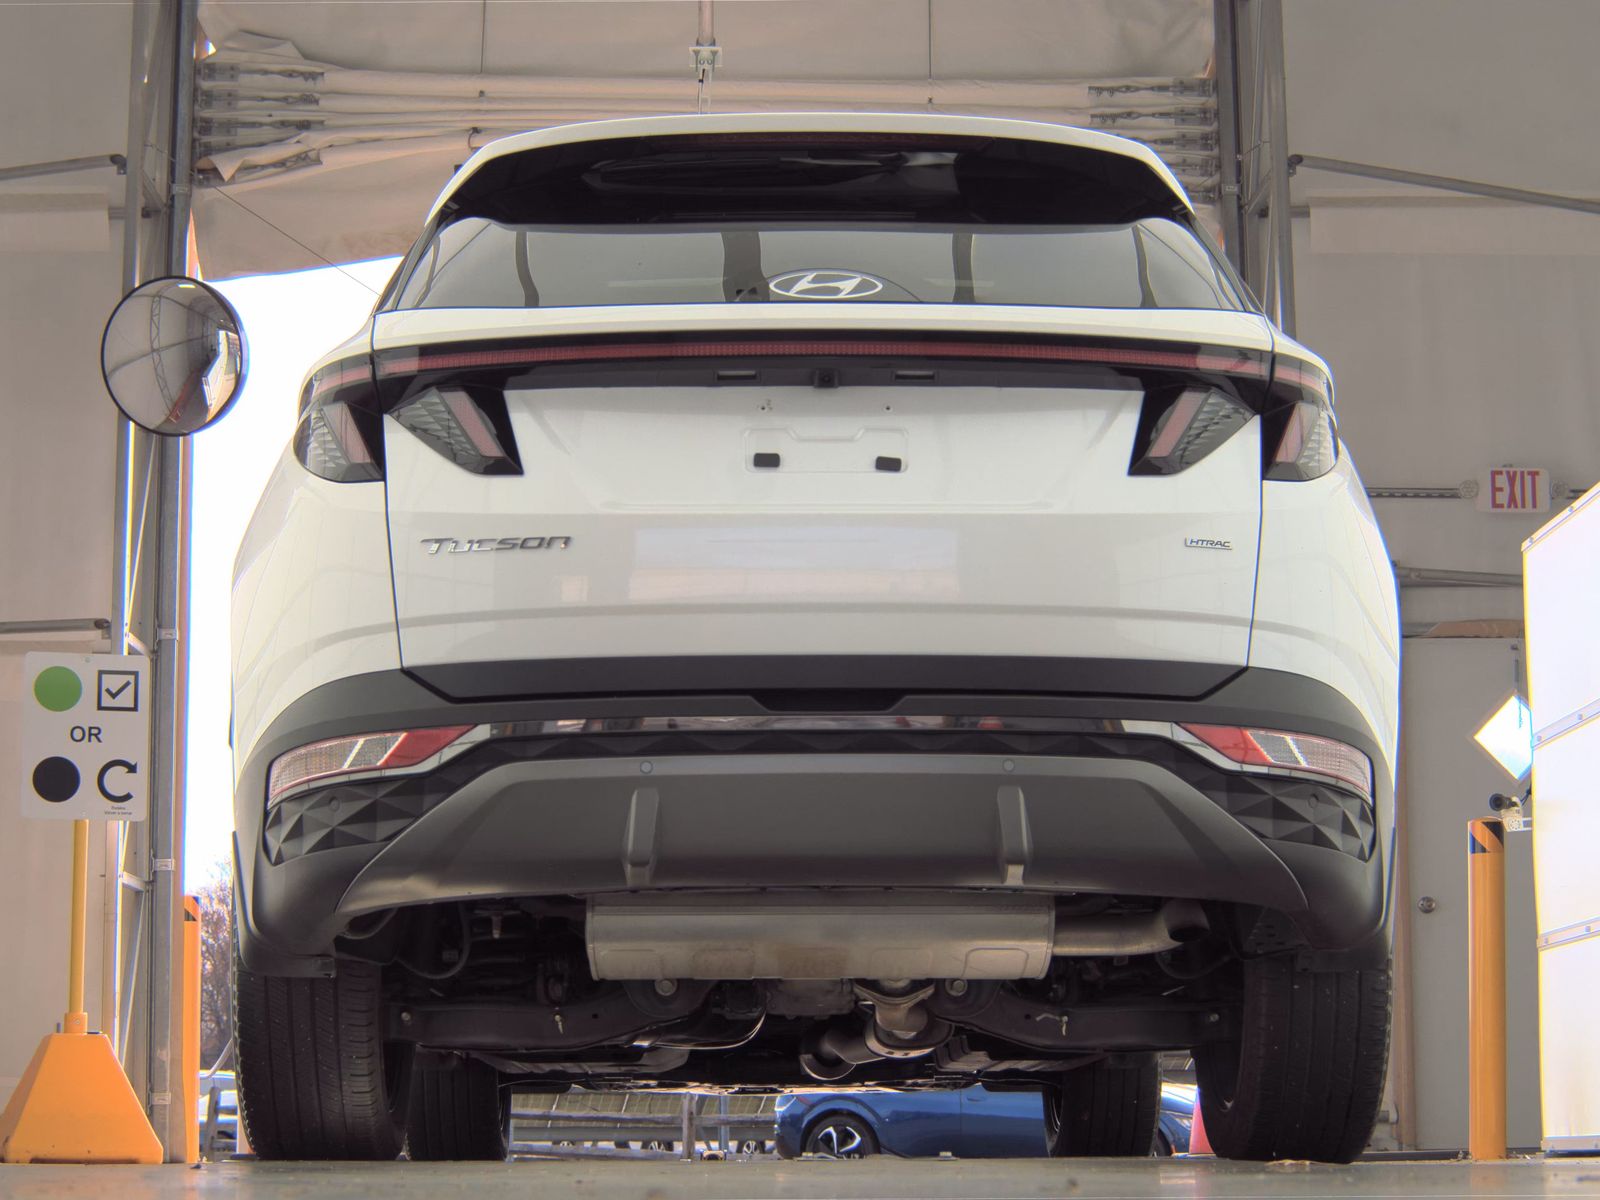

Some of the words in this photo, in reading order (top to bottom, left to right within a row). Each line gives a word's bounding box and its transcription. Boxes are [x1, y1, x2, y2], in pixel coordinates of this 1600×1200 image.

[1490, 470, 1540, 509] EXIT
[1189, 538, 1232, 548] HTRAC
[69, 725, 103, 743] OR
